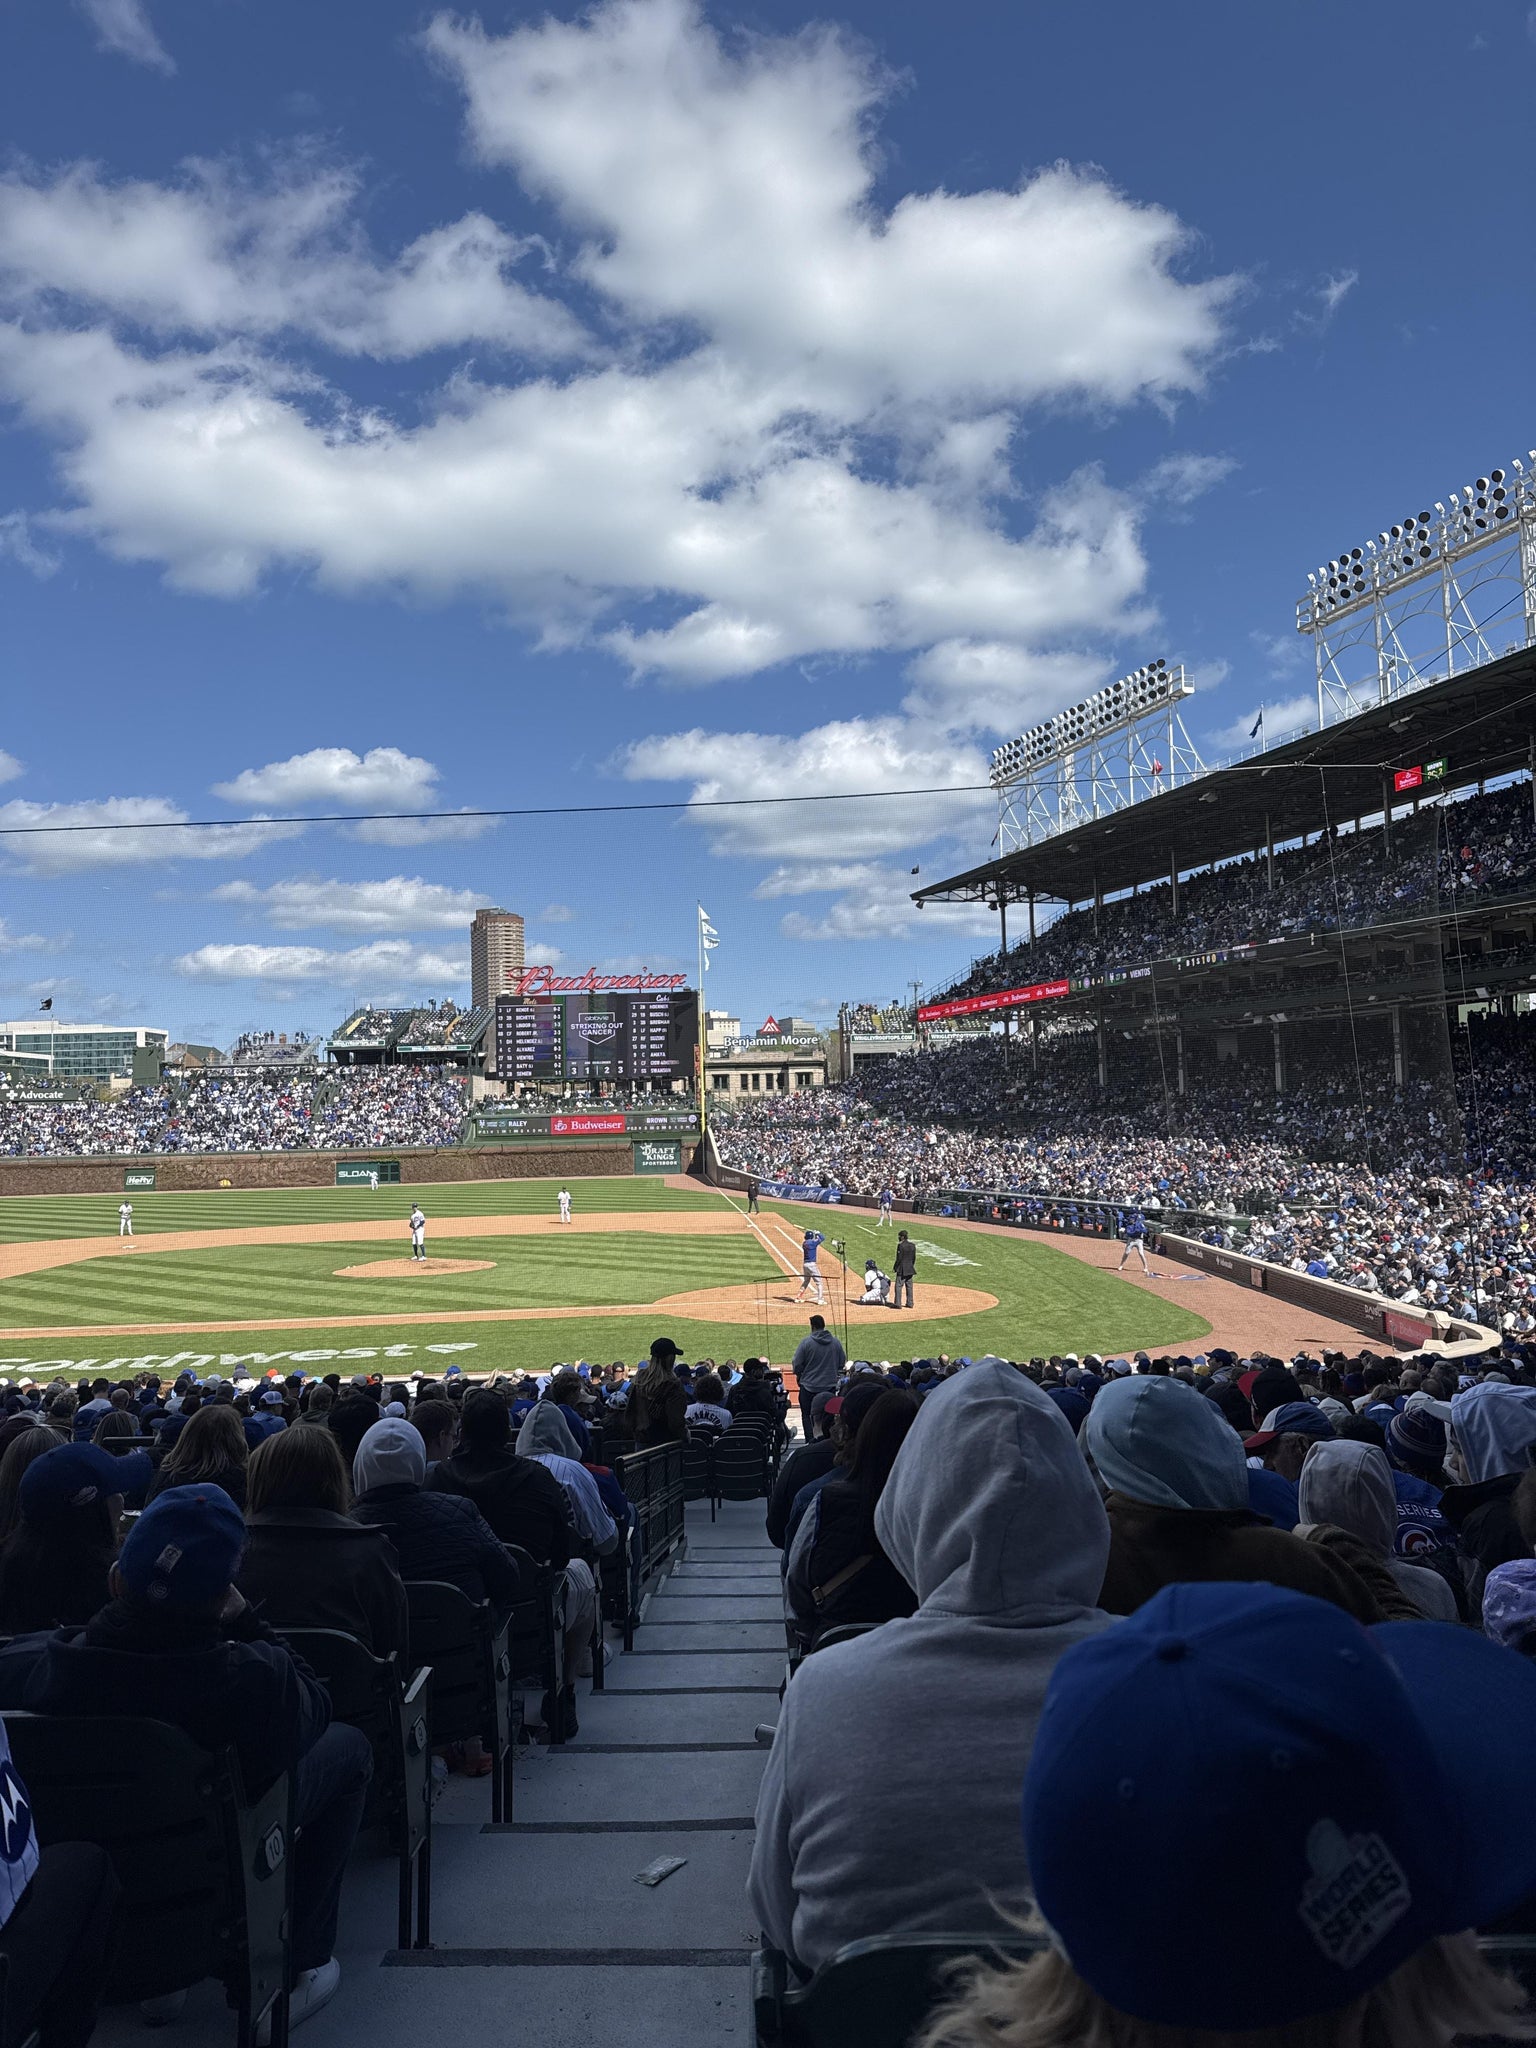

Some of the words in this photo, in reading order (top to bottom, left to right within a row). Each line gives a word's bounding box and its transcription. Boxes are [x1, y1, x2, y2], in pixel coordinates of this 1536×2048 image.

[1130, 967, 1151, 979] VIENTOS
[508, 965, 687, 995] Budweiser
[1045, 985, 1067, 995] Budweiser
[724, 1035, 778, 1048] Benjamin
[781, 1035, 819, 1046] Moore
[571, 1067, 577, 1075] 3
[584, 1067, 590, 1075] 1
[604, 1066, 610, 1074] 2
[617, 1066, 624, 1074] 3
[20, 1090, 64, 1099] Advocate
[571, 1120, 622, 1130] Budweiser
[642, 1147, 676, 1156] DRAFT
[646, 1153, 675, 1161] KINGS
[128, 1176, 152, 1185] Hefty
[1396, 1503, 1443, 1518] SERIES
[269, 1836, 281, 1861] 10
[1304, 1840, 1387, 1923] WORLD
[1316, 1863, 1404, 1954] SERIES
